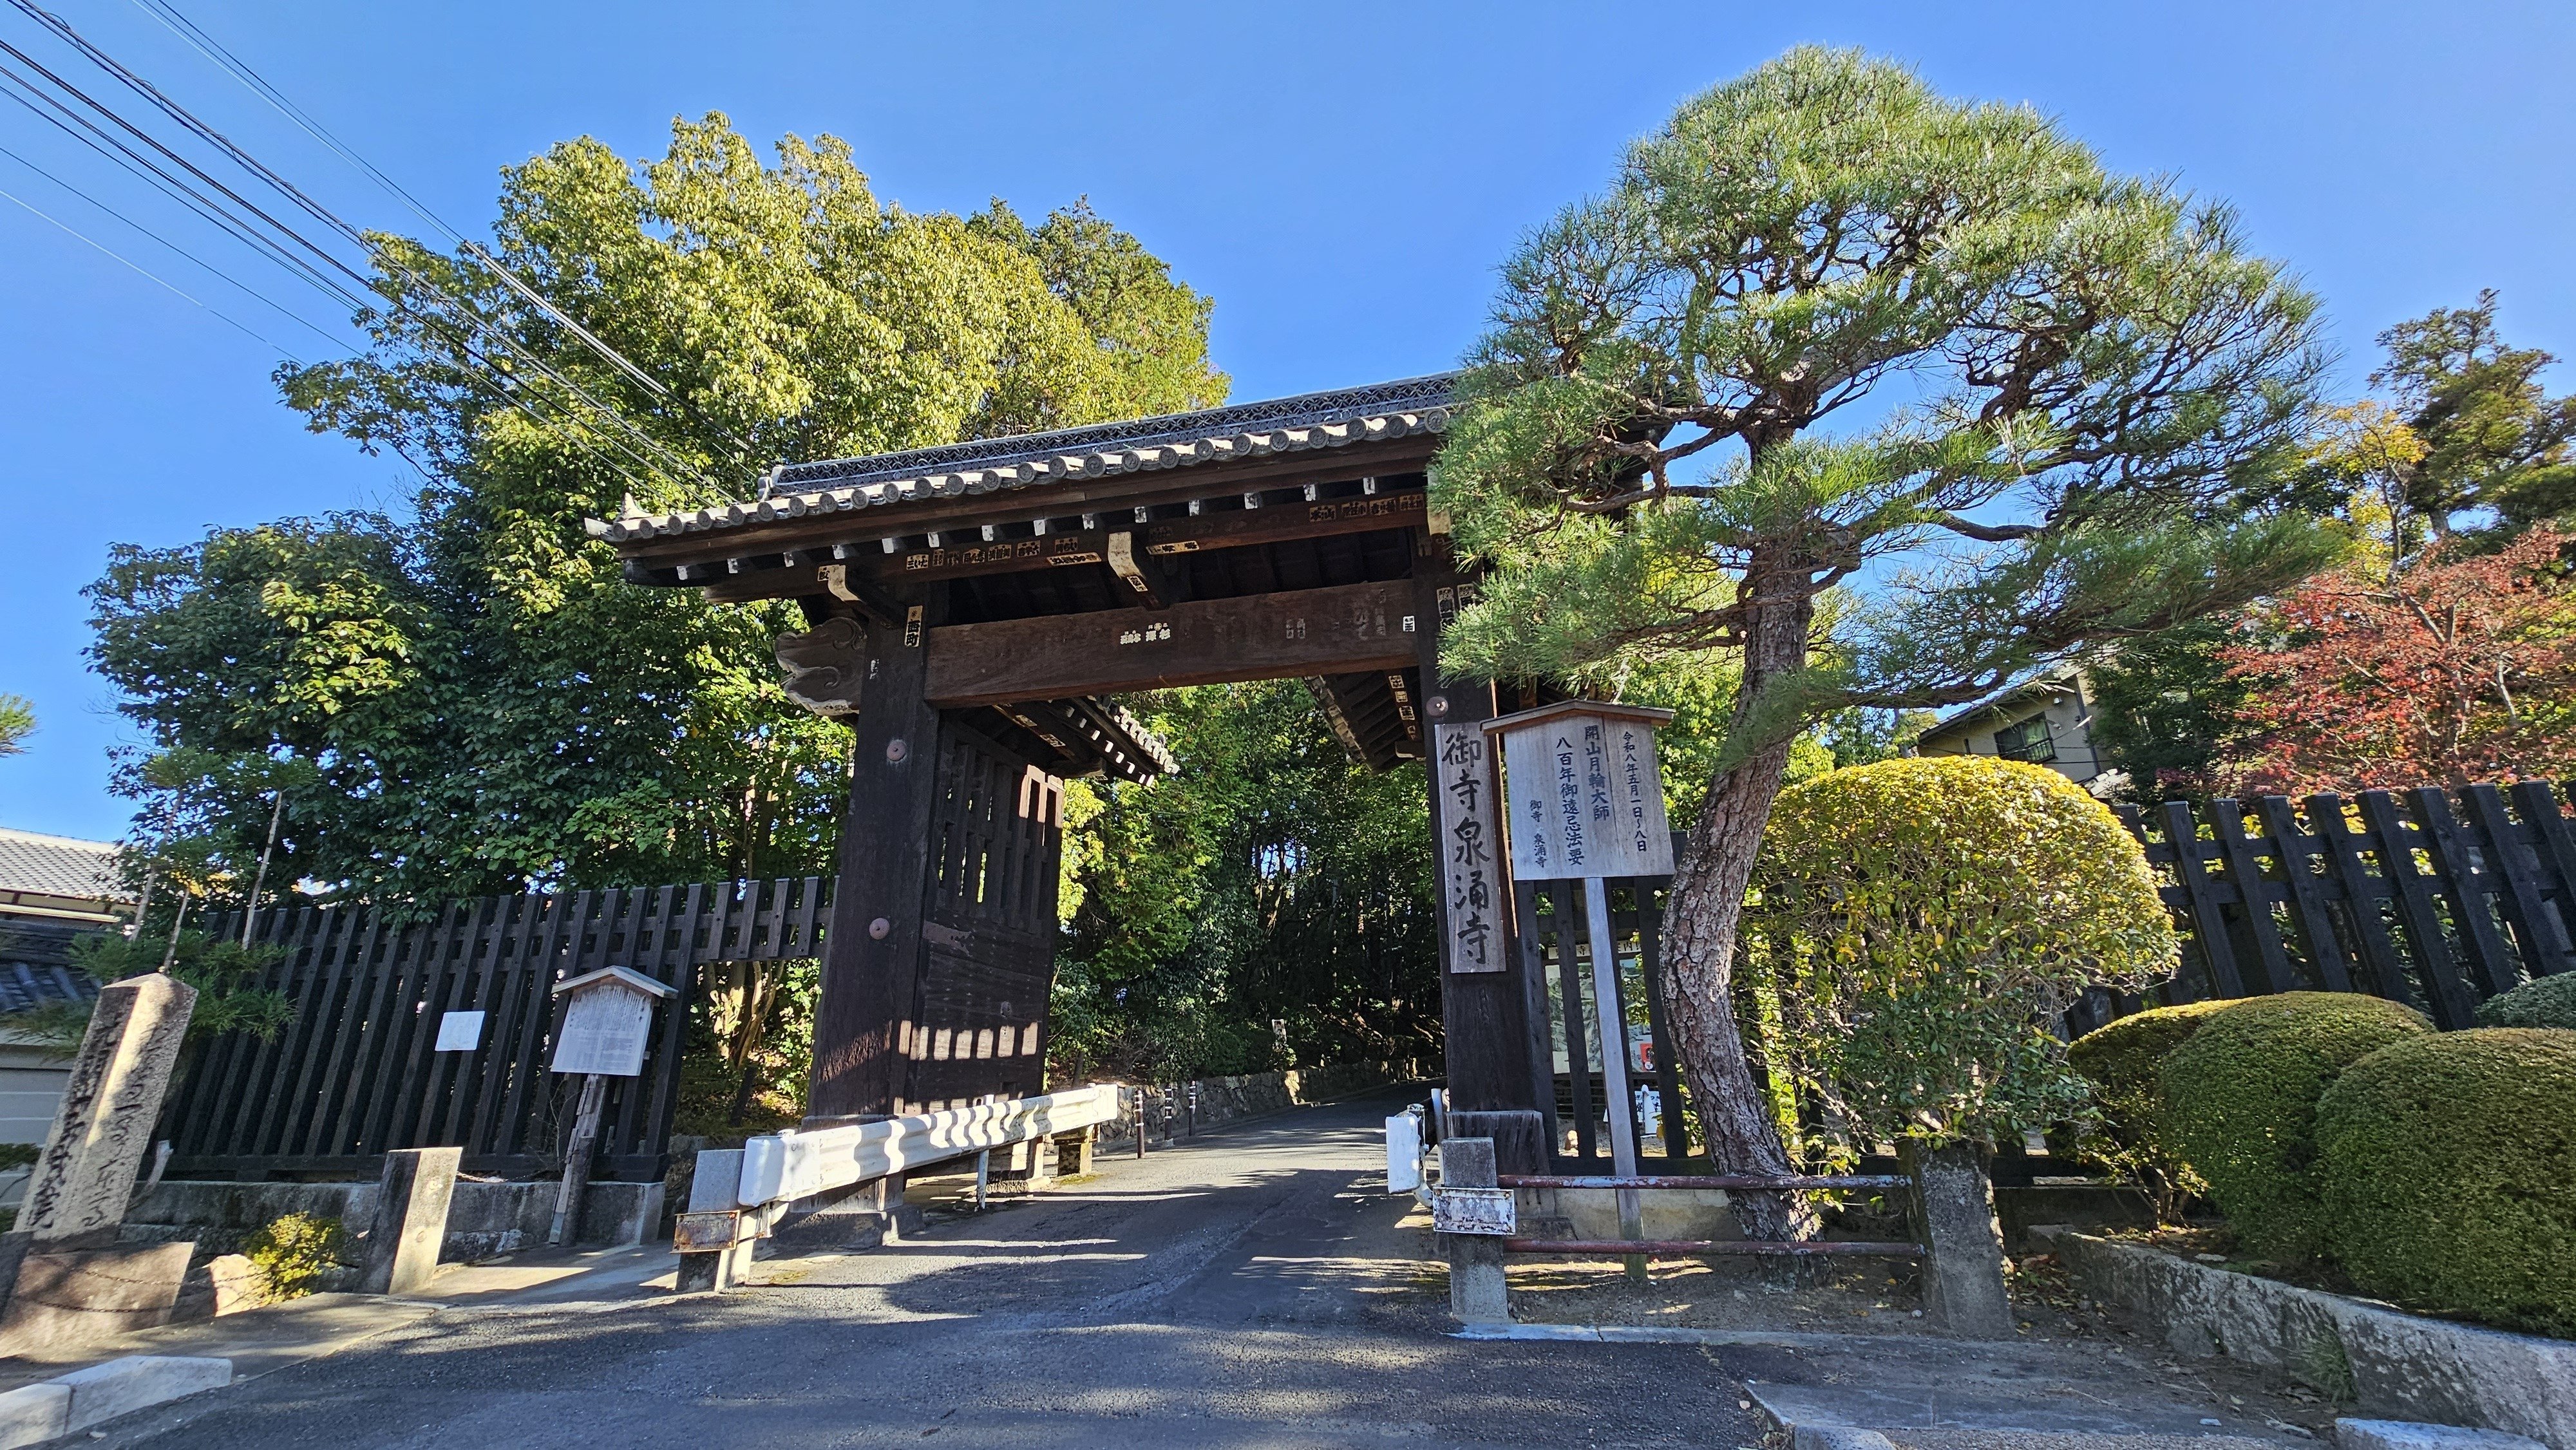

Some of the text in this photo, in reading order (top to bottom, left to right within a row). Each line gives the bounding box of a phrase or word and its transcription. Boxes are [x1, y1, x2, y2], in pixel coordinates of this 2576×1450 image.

[1530, 799, 1542, 823] 御寺
[1556, 737, 1585, 866] 八百年御遠忌法要
[1584, 724, 1610, 822] 開山月輪大師
[1441, 731, 1490, 965] 御寺泉涌寺
[1533, 833, 1547, 868] 泉涌寺
